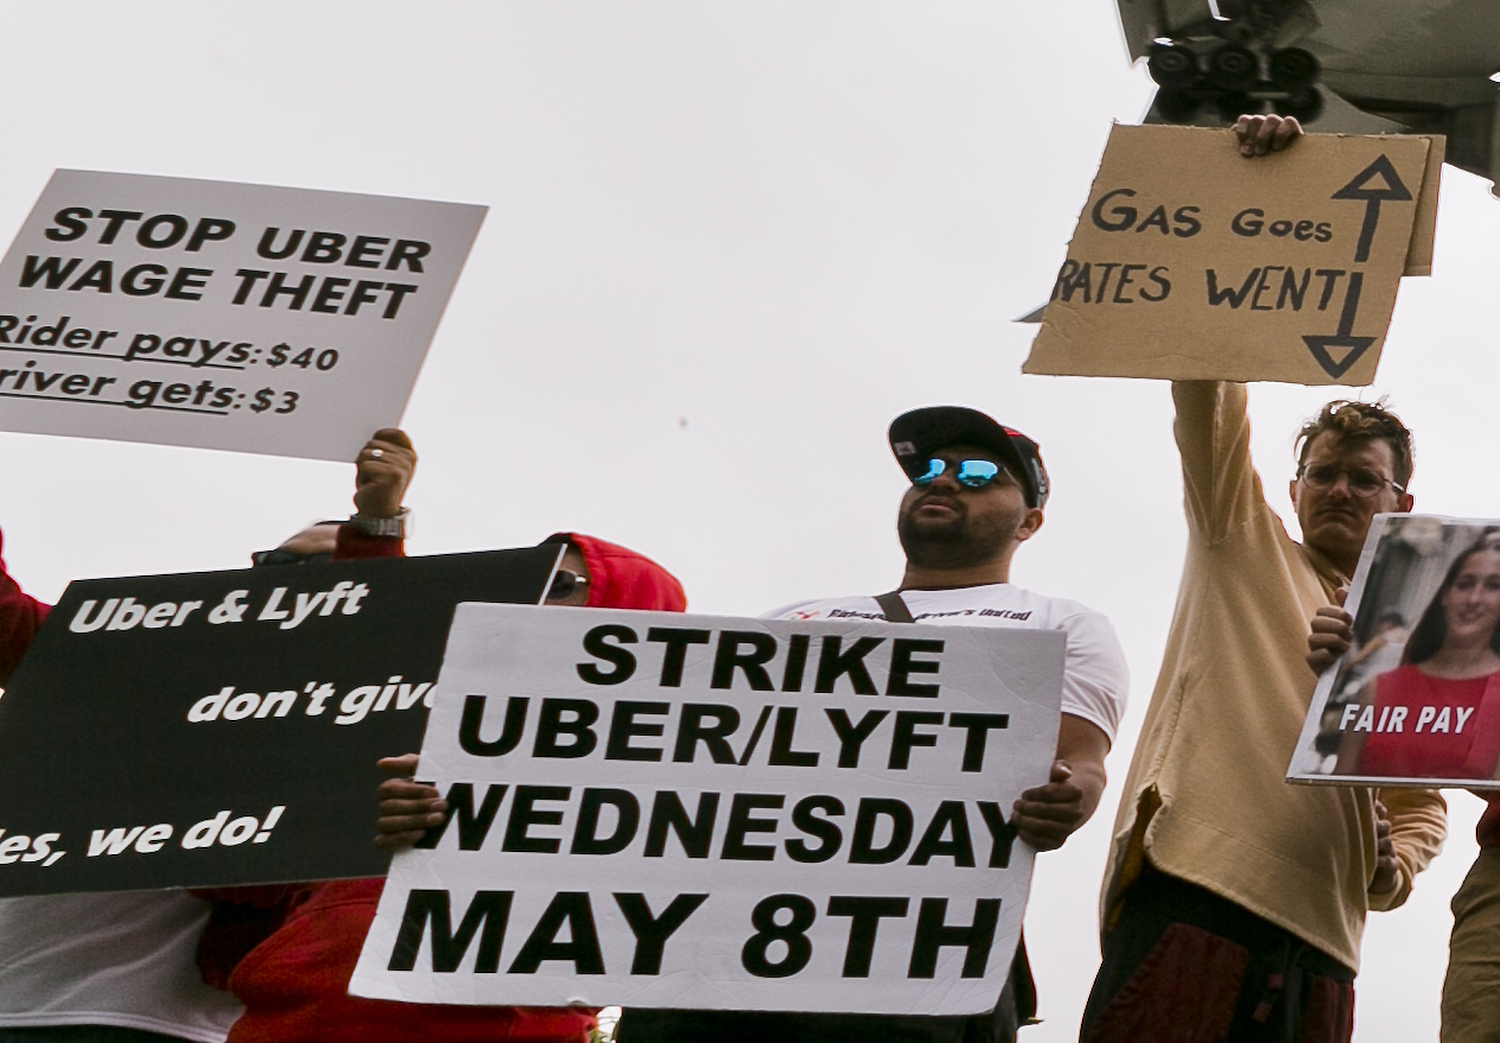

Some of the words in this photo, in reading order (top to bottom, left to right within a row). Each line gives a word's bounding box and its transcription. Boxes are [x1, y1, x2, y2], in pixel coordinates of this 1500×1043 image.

[45, 206, 236, 253] STOP
[256, 226, 432, 273] UBER
[1231, 208, 1333, 243] Goes
[18, 254, 214, 302] WAGE
[231, 268, 418, 319] THEFT
[1050, 259, 1171, 304] RATES
[1205, 265, 1347, 312] WENT
[0, 314, 118, 350] Rider
[0, 359, 117, 397] river
[68, 593, 203, 634] Uber
[206, 588, 248, 626] &
[256, 580, 370, 631] Lyft
[576, 624, 945, 700] STRIKE
[187, 678, 336, 724] don't
[1338, 703, 1409, 734] FAIR
[1415, 705, 1475, 735] PAY
[458, 694, 1010, 774] UBER/LYFT
[0, 828, 67, 867] es,
[86, 821, 174, 858] we
[181, 805, 286, 853] do!
[412, 781, 1020, 869] WEDNESDAY
[387, 888, 710, 977] MAY
[740, 893, 1003, 981] 8TH
